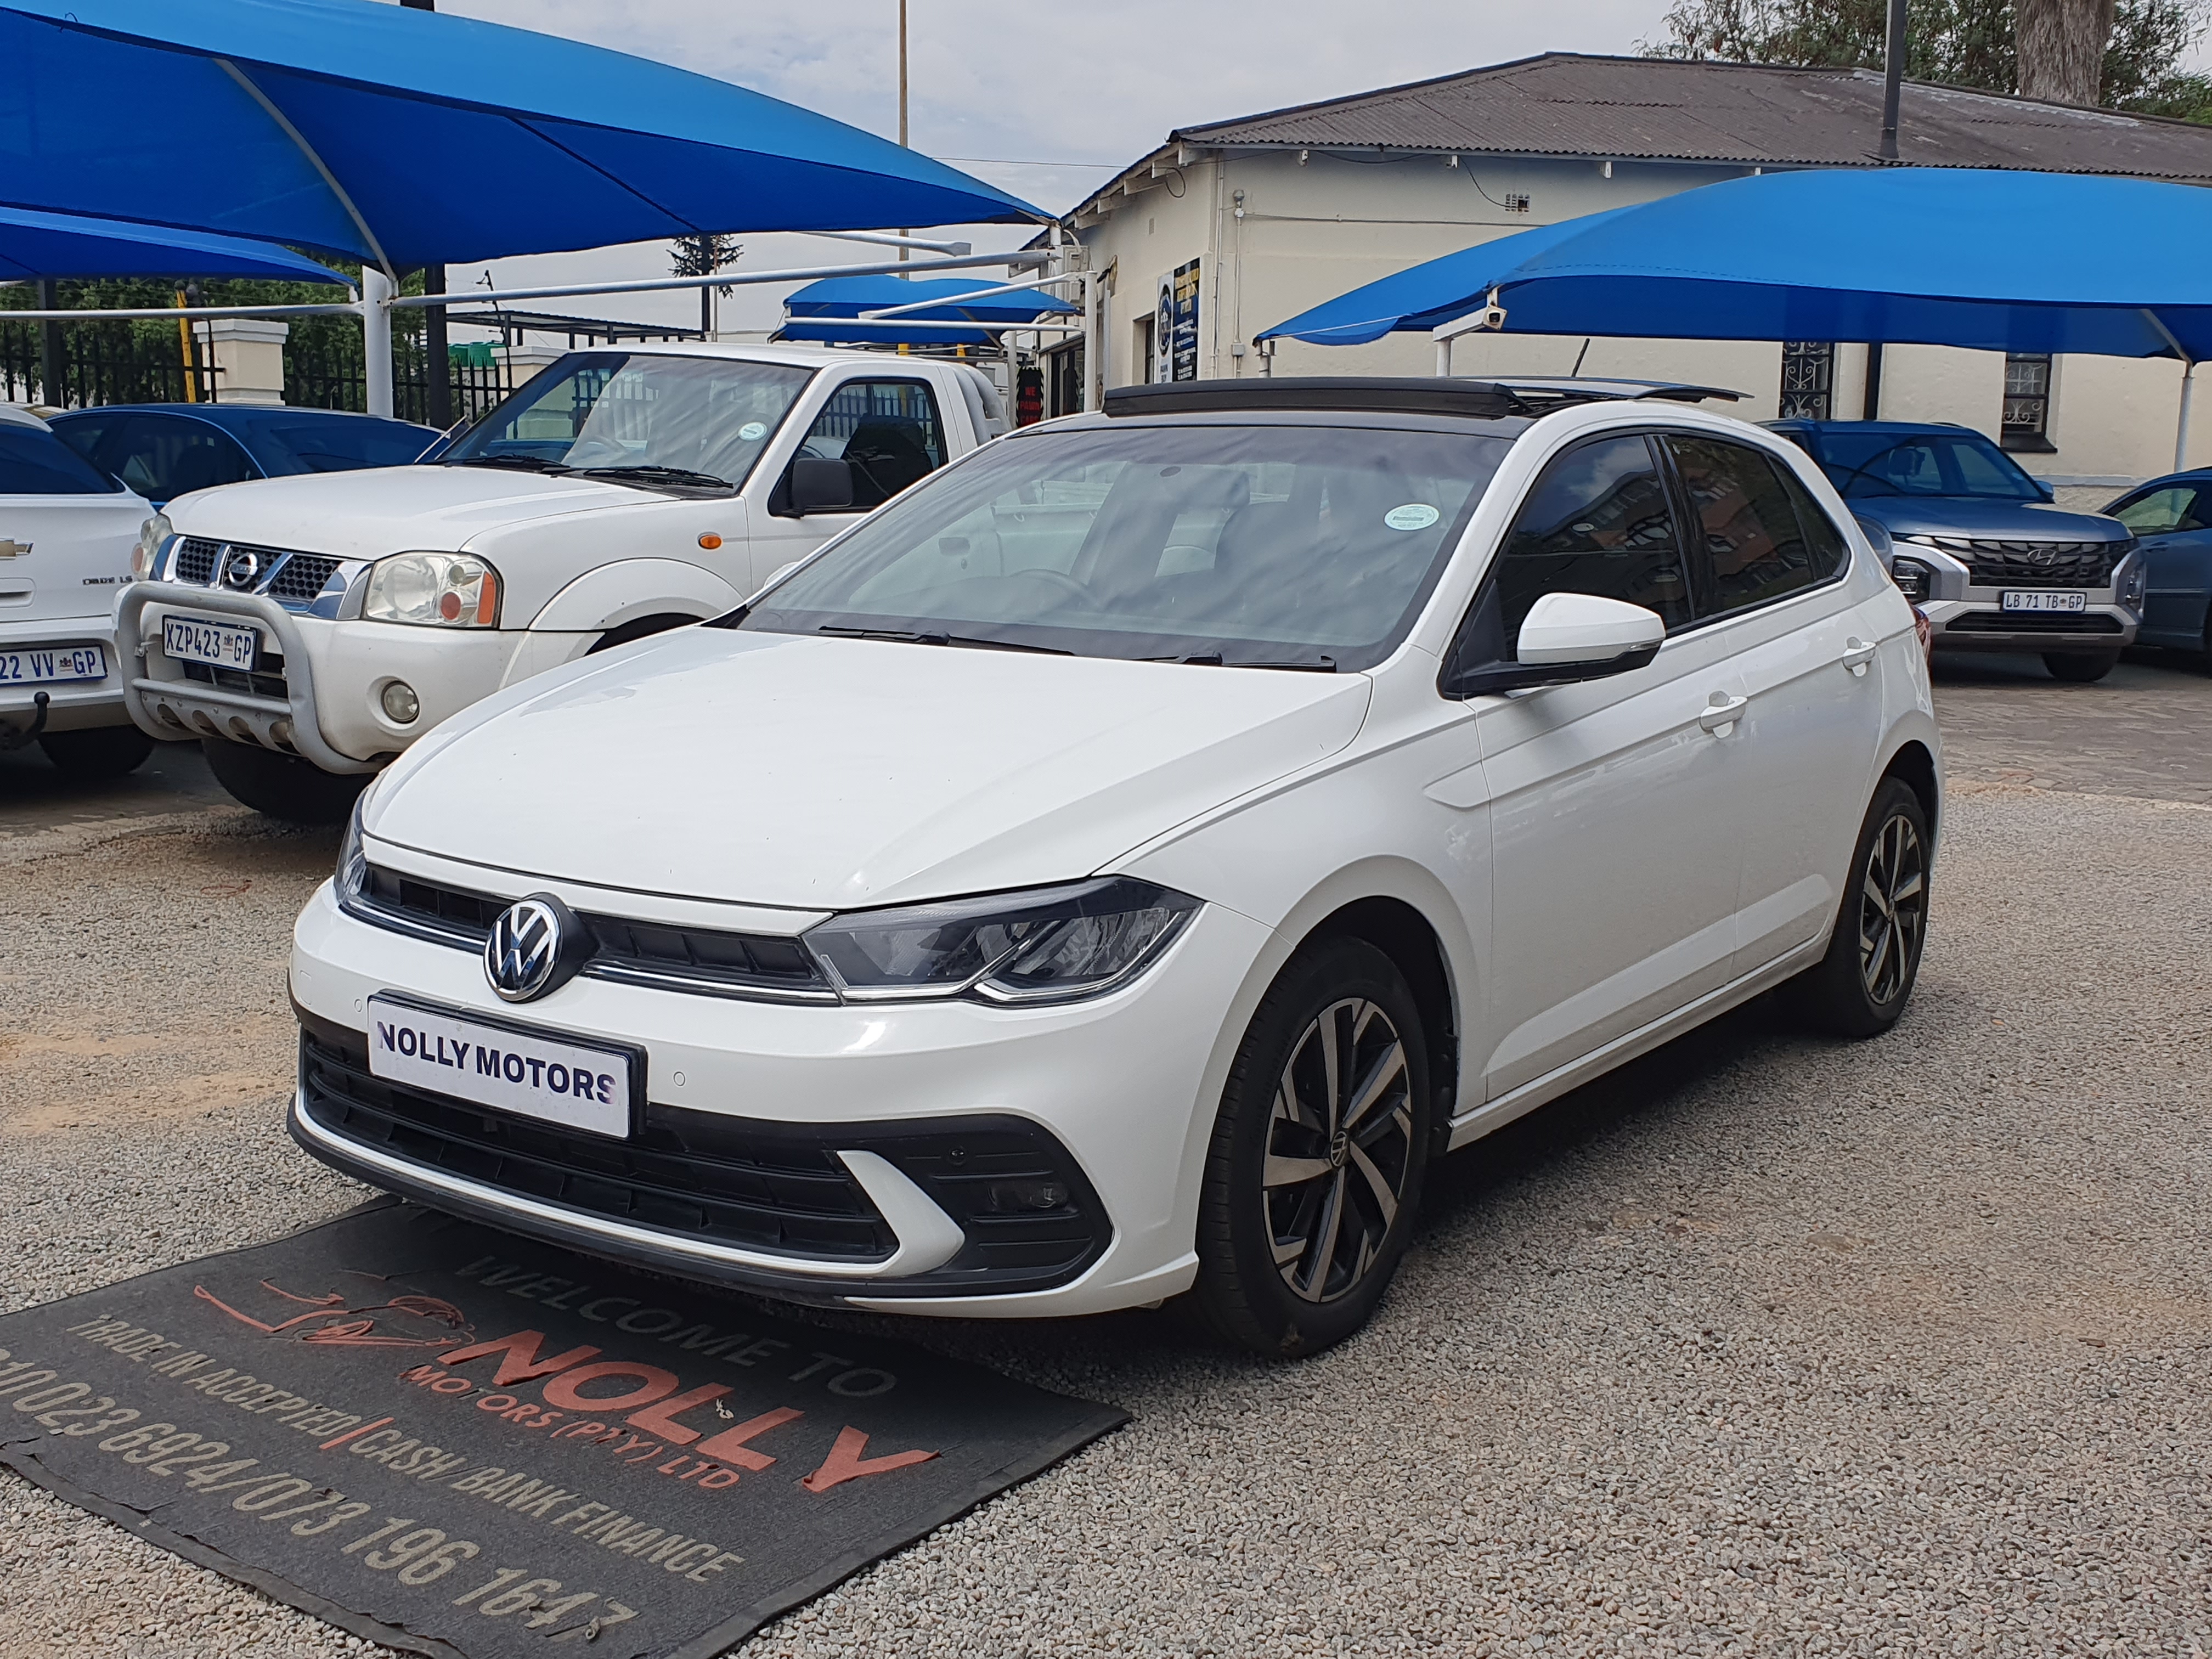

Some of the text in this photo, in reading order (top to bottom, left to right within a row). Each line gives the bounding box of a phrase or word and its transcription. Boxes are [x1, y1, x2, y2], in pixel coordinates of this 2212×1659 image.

[1025, 386, 1036, 396] WE
[2006, 594, 2083, 609] LB 71 TB GP
[30, 652, 54, 678] VV
[72, 650, 96, 674] GP
[166, 623, 252, 664] XZP423 GP
[376, 1020, 616, 1105] NOLLY MOTORS
[455, 1255, 898, 1397] WELCOME TO
[436, 1328, 942, 1493] NOLLY
[150, 1350, 217, 1378] IN
[550, 1500, 747, 1582] FINANCE
[340, 1516, 481, 1586] 196
